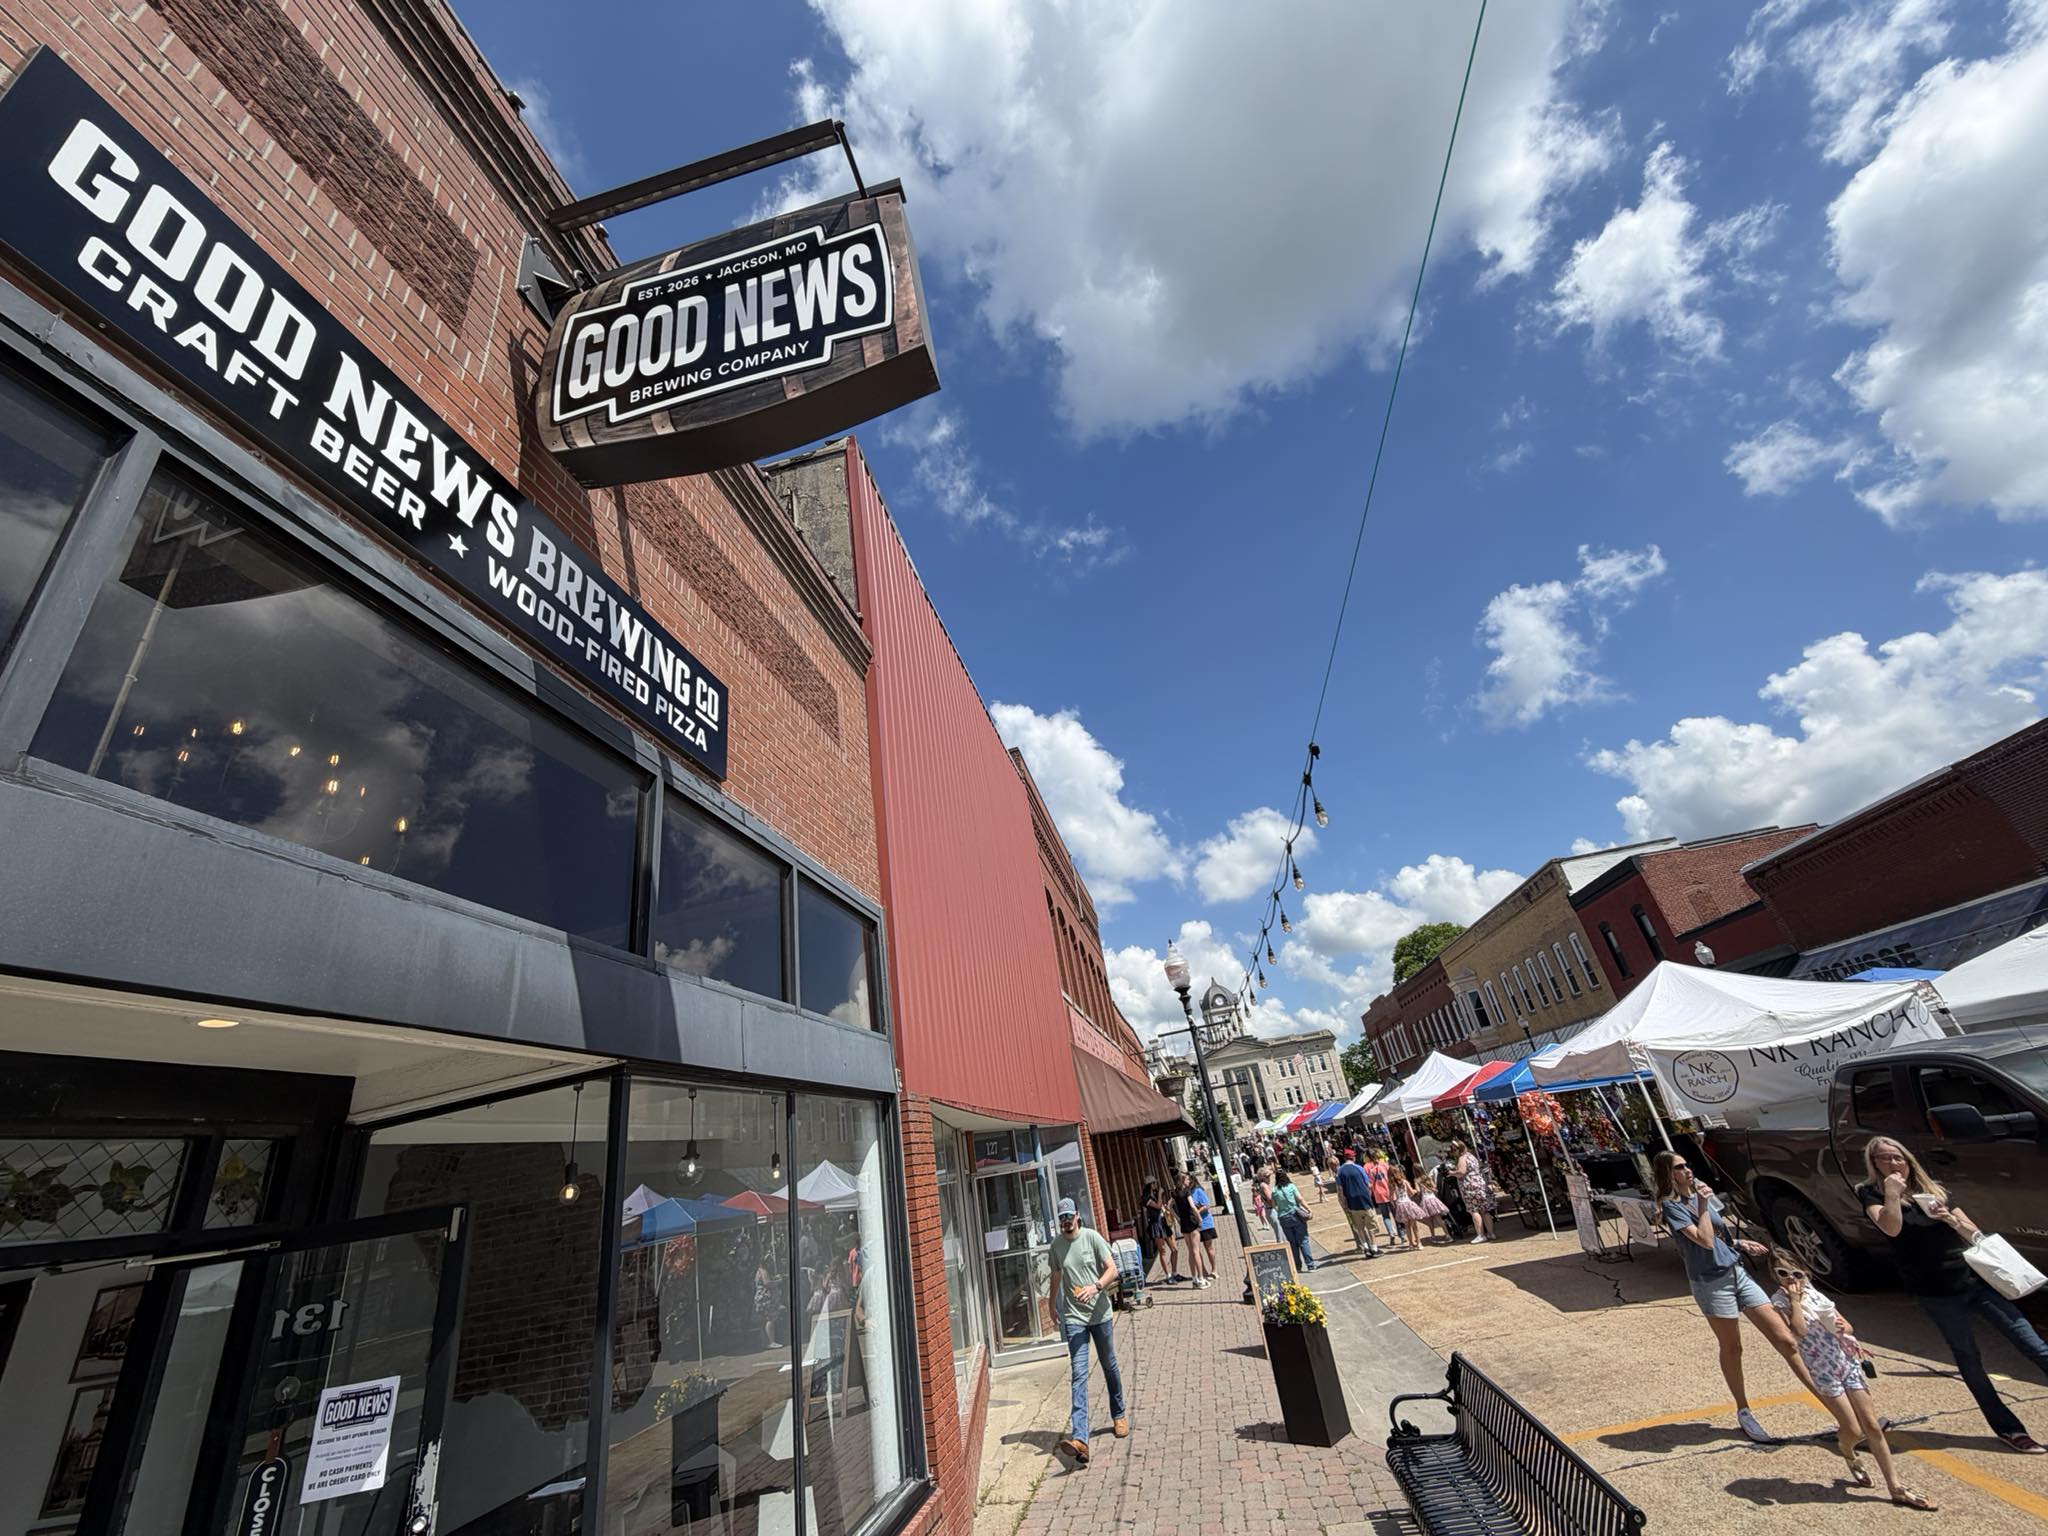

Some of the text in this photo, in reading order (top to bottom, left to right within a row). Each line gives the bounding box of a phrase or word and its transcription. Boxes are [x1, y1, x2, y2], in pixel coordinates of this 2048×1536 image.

[638, 241, 808, 302] EST. 2026 JACKSON, MO
[568, 242, 878, 400] GOOD NEWS
[77, 236, 426, 531] CRAFT BEER
[629, 340, 810, 404] BREWING COMPANY
[47, 117, 719, 727] GOOD NEWS BREWING CO
[488, 555, 708, 752] WOOD-FIRED PIZZA
[1749, 1007, 1917, 1067] NK RANCH
[1687, 1074, 1728, 1088] RANCH
[1688, 1061, 1717, 1076] NK
[985, 1141, 998, 1156] 127
[324, 1399, 357, 1424] GOOD
[357, 1391, 390, 1417] NEWS
[308, 1482, 316, 1490] WE
[317, 1480, 328, 1489] ARE
[329, 1476, 350, 1487] CREDIT
[350, 1473, 366, 1482] CARD
[319, 1461, 373, 1478] NO CASH PAYMENTS
